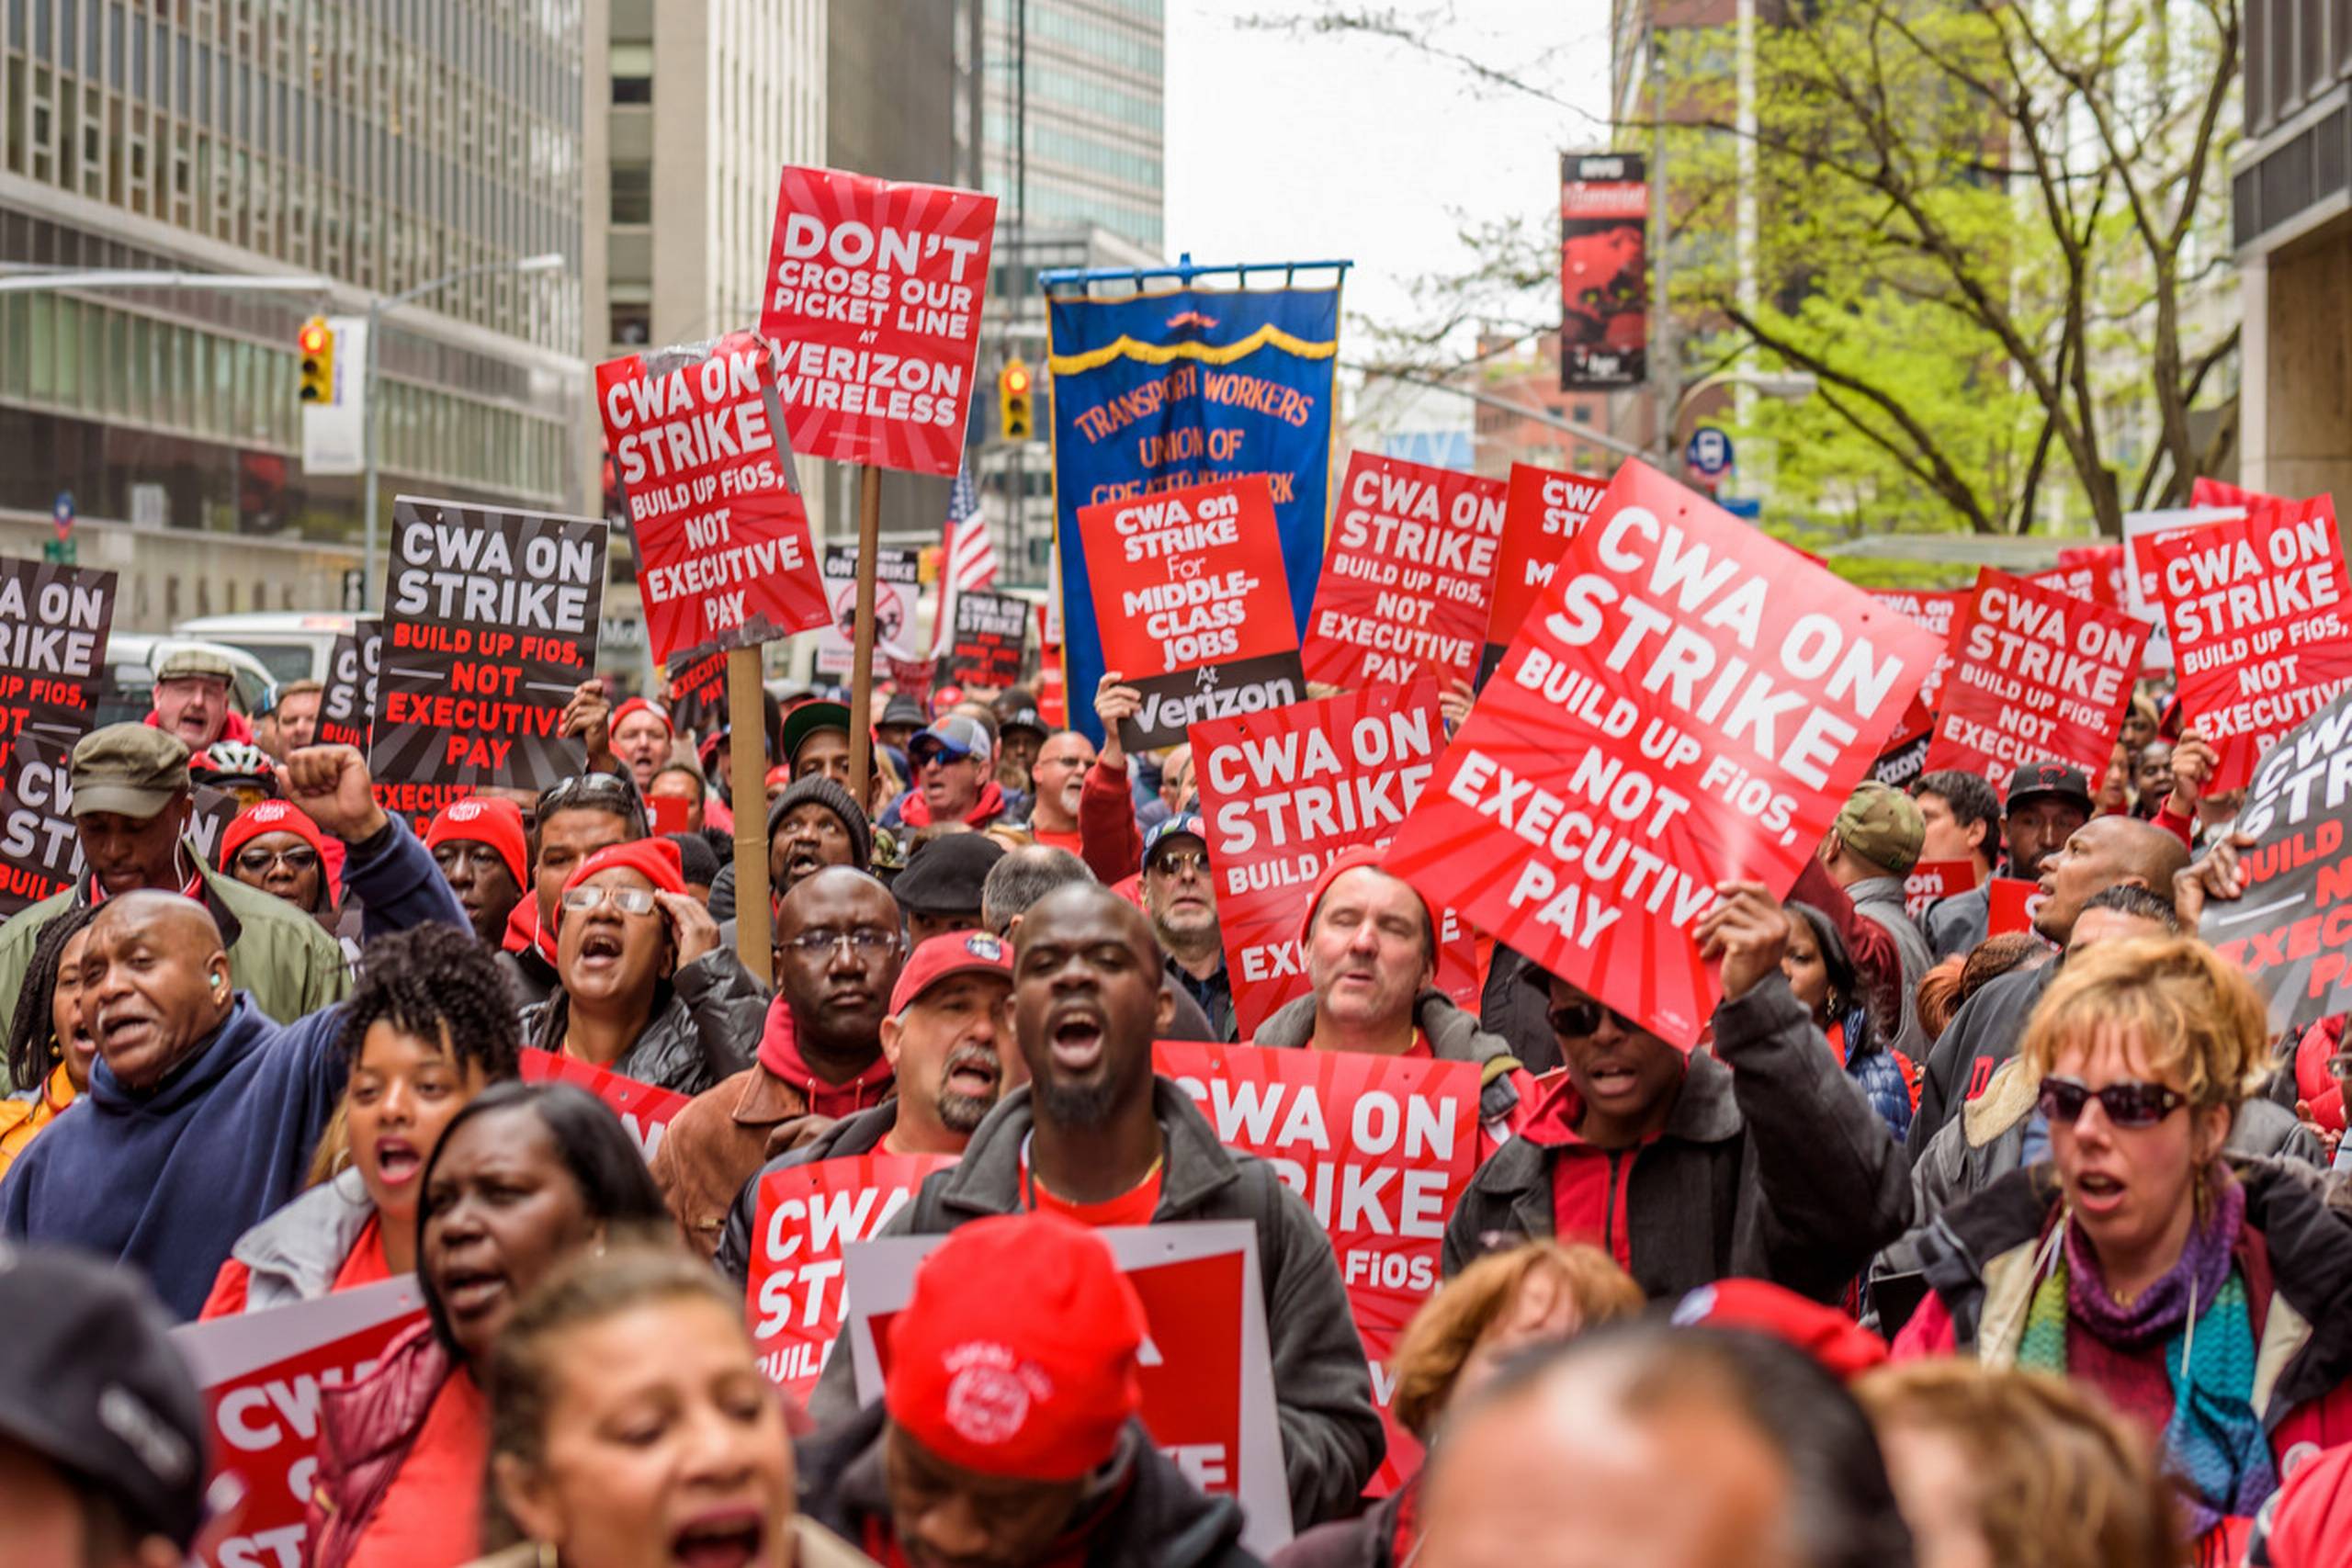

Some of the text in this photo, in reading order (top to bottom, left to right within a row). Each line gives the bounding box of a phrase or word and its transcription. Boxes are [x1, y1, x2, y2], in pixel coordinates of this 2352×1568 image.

[784, 212, 979, 283] DON'T
[778, 261, 972, 312] CROSS OUR
[774, 288, 969, 340] PICKET LINE
[858, 331, 878, 344] AT
[607, 349, 762, 429] CWA ON
[769, 338, 962, 397] VERIZON
[777, 374, 957, 427] WIRELESS
[1074, 365, 1315, 446] TRANSPORT WORKERS
[617, 399, 774, 484] STRIKE
[1139, 427, 1246, 468] UNION OF
[630, 483, 691, 521] BUILD
[693, 475, 718, 504] UP
[1114, 493, 1239, 536] CWA on
[1351, 469, 1442, 524] CWA
[1451, 491, 1508, 536] ON
[402, 522, 594, 584] CWA ON
[684, 508, 731, 551] NOT
[1124, 517, 1239, 563] STRIKE
[1339, 509, 1498, 578] STRIKE
[648, 535, 804, 603] EXECUTIVE
[827, 556, 854, 577] ON
[1166, 556, 1206, 581] For
[1332, 553, 1398, 587] BUILD
[1401, 570, 1432, 593] UP
[2165, 538, 2263, 598] CWA
[2267, 516, 2332, 568] ON
[39, 582, 103, 630] ON
[394, 570, 589, 634] STRIKE
[704, 590, 746, 631] PAY
[959, 595, 999, 617] CWA
[1123, 570, 1260, 617] MIDDLE-
[1374, 591, 1435, 627] NOT
[1597, 506, 1768, 650] CWA
[1780, 613, 1905, 721] ON
[1925, 600, 1954, 618] on
[2173, 560, 2340, 645] STRIKE
[392, 623, 472, 654] BUILD
[479, 631, 515, 658] UP
[957, 613, 1023, 637] STRIKE
[1147, 599, 1246, 640] CLASS
[1317, 610, 1475, 668] EXECUTIVE
[1979, 587, 2066, 648] CWA
[2075, 621, 2137, 669] ON
[0, 621, 96, 677] RIKE
[1162, 628, 1239, 672] JOBS
[1362, 651, 1418, 686] PAY
[1966, 624, 2124, 707] STRIKE
[2182, 637, 2249, 676] BUILD
[2252, 626, 2284, 657] UP
[451, 660, 523, 697] NOT
[1195, 664, 1219, 685] At
[1544, 573, 1859, 794] STRIKE
[1959, 661, 2022, 701] BUILD
[2024, 687, 2056, 711] UP
[2237, 654, 2300, 697] NOT
[386, 692, 567, 739] EXECUTIV
[1134, 676, 1296, 734] Verizon
[1997, 704, 2057, 745] NOT
[447, 736, 512, 770] PAY
[1207, 706, 1432, 796] CWA ON
[1513, 647, 1800, 848] BUILD UP FiOS,
[2256, 703, 2352, 802] CW
[370, 783, 478, 812] EXECUT
[1569, 745, 1690, 840] NOT
[1227, 852, 1320, 897] BUILD
[1507, 861, 1623, 953] PAY
[1351, 1090, 1458, 1161] ON
[216, 1359, 379, 1451] CW
